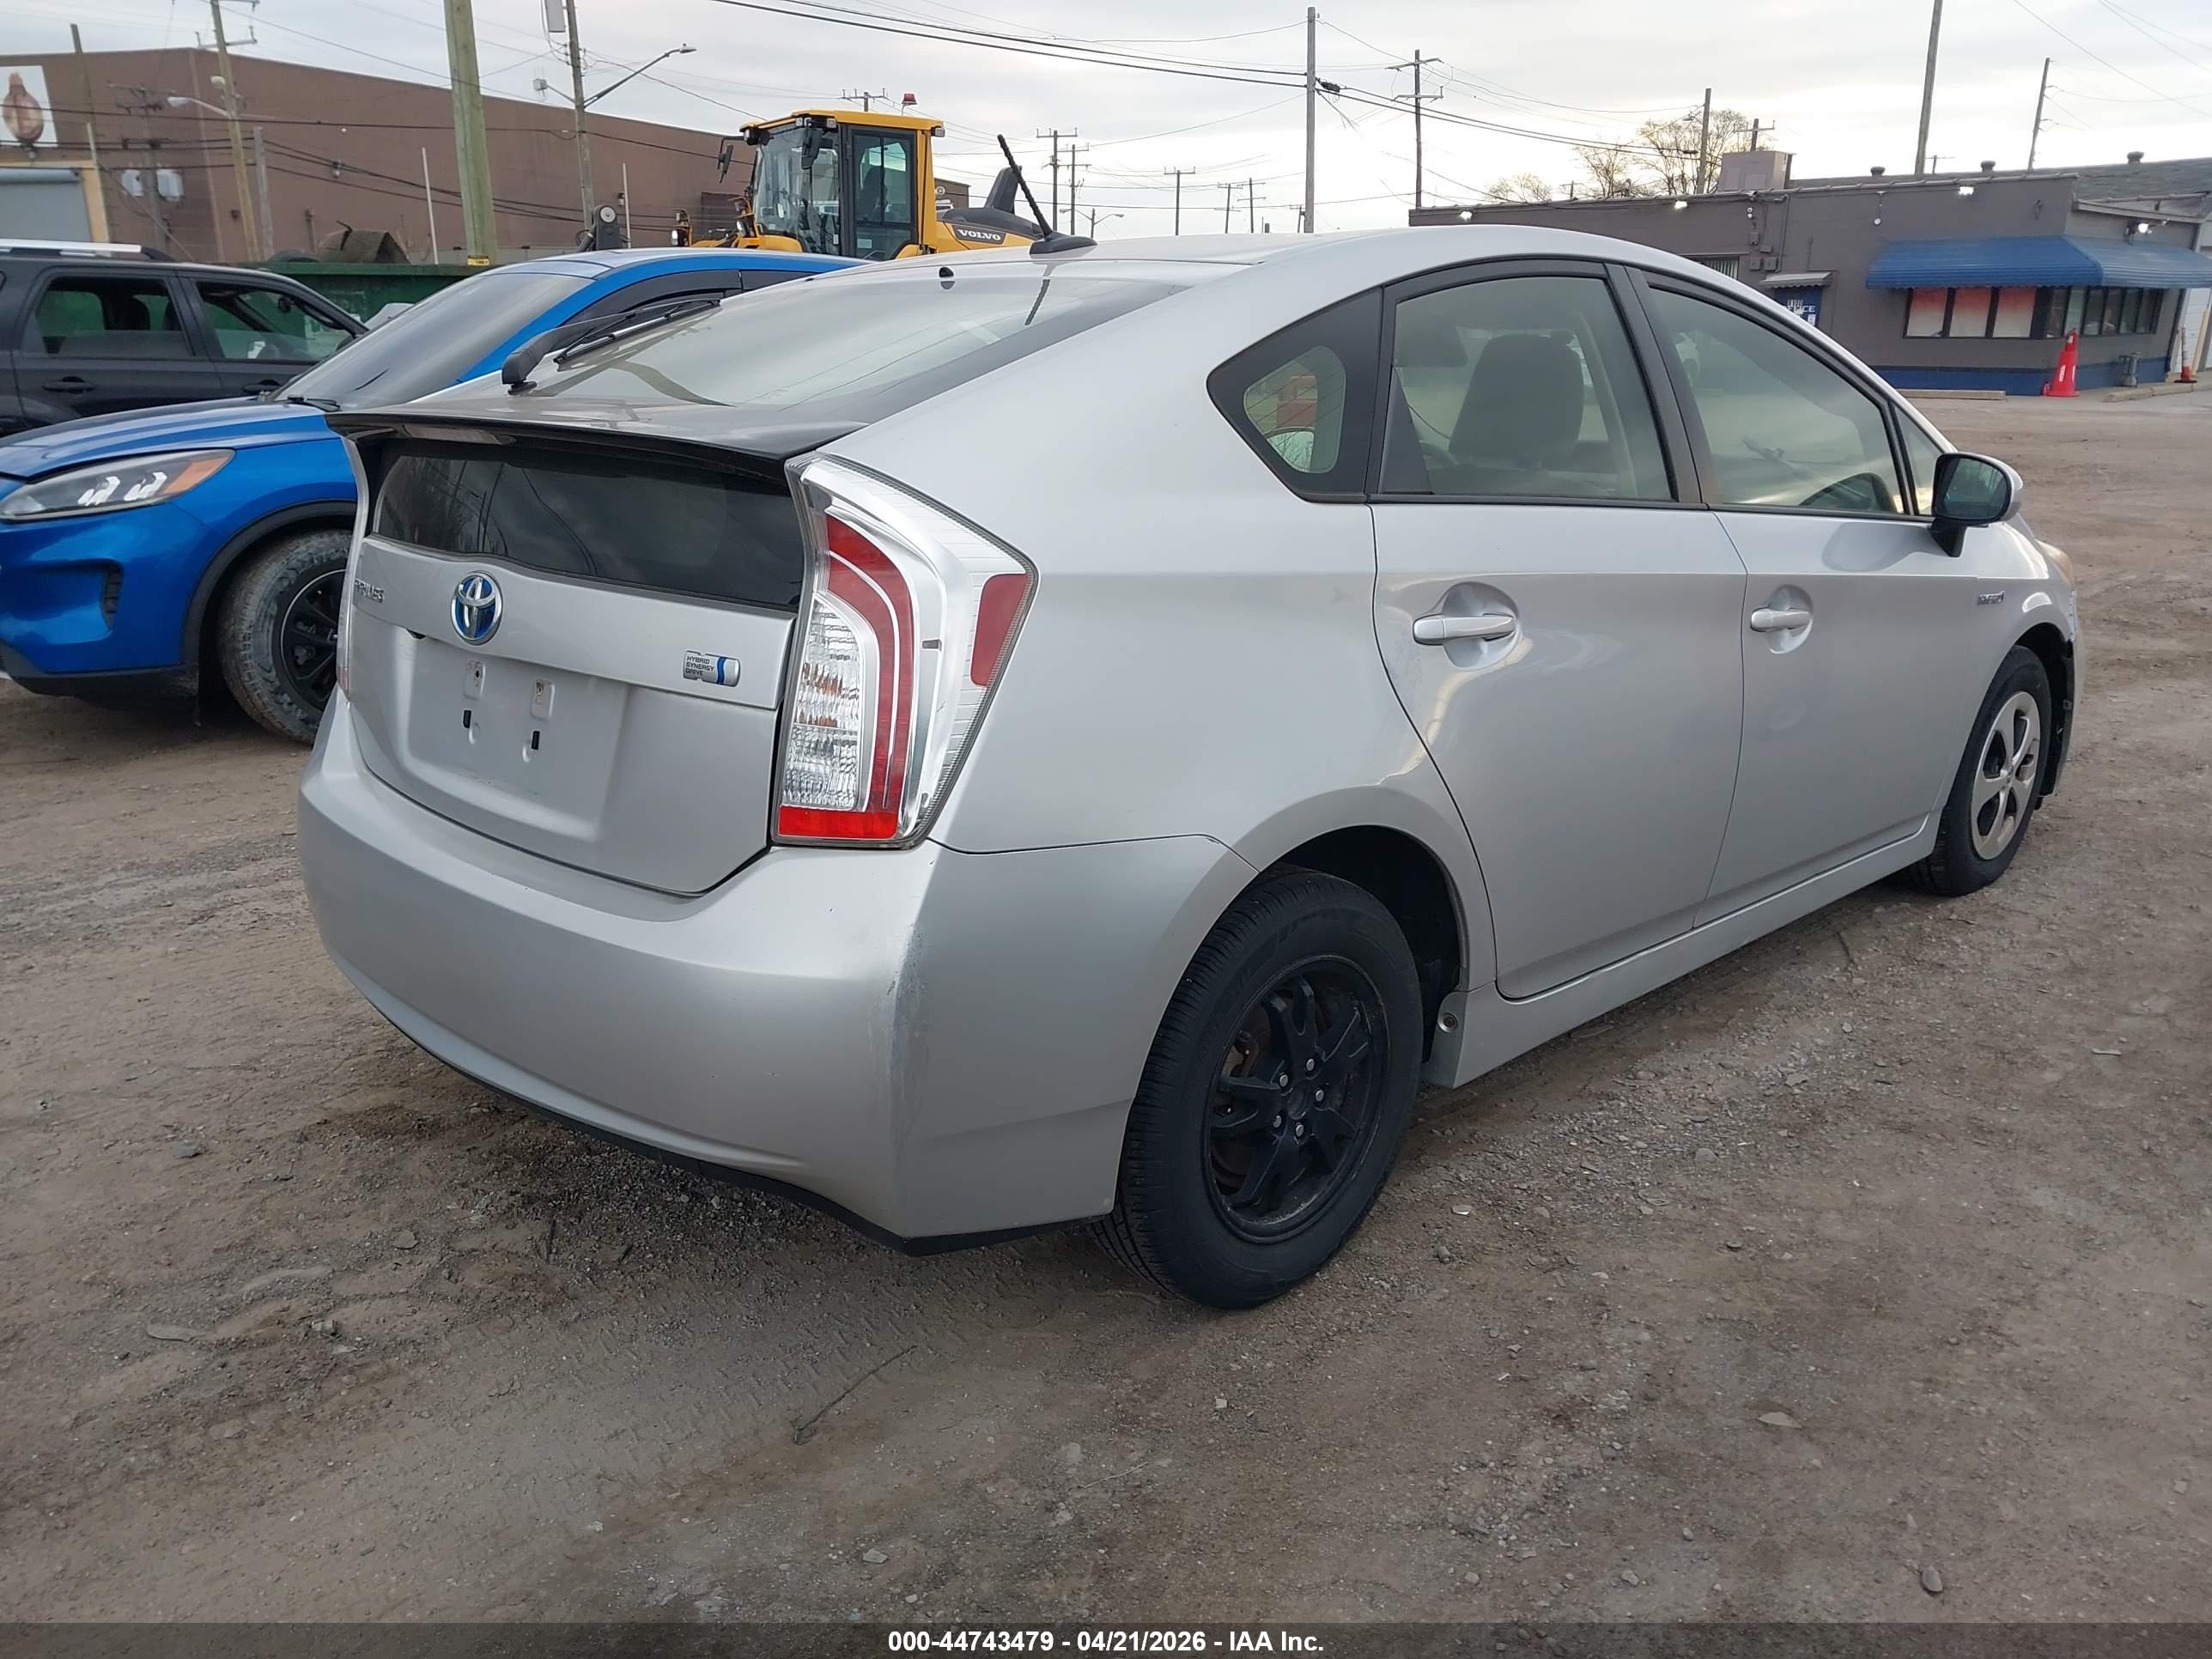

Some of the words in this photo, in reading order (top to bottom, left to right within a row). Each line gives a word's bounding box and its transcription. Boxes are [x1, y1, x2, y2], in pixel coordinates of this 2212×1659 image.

[957, 228, 1001, 241] VOLVO
[687, 655, 710, 665] HYBRID
[685, 662, 714, 672] SYNERGY
